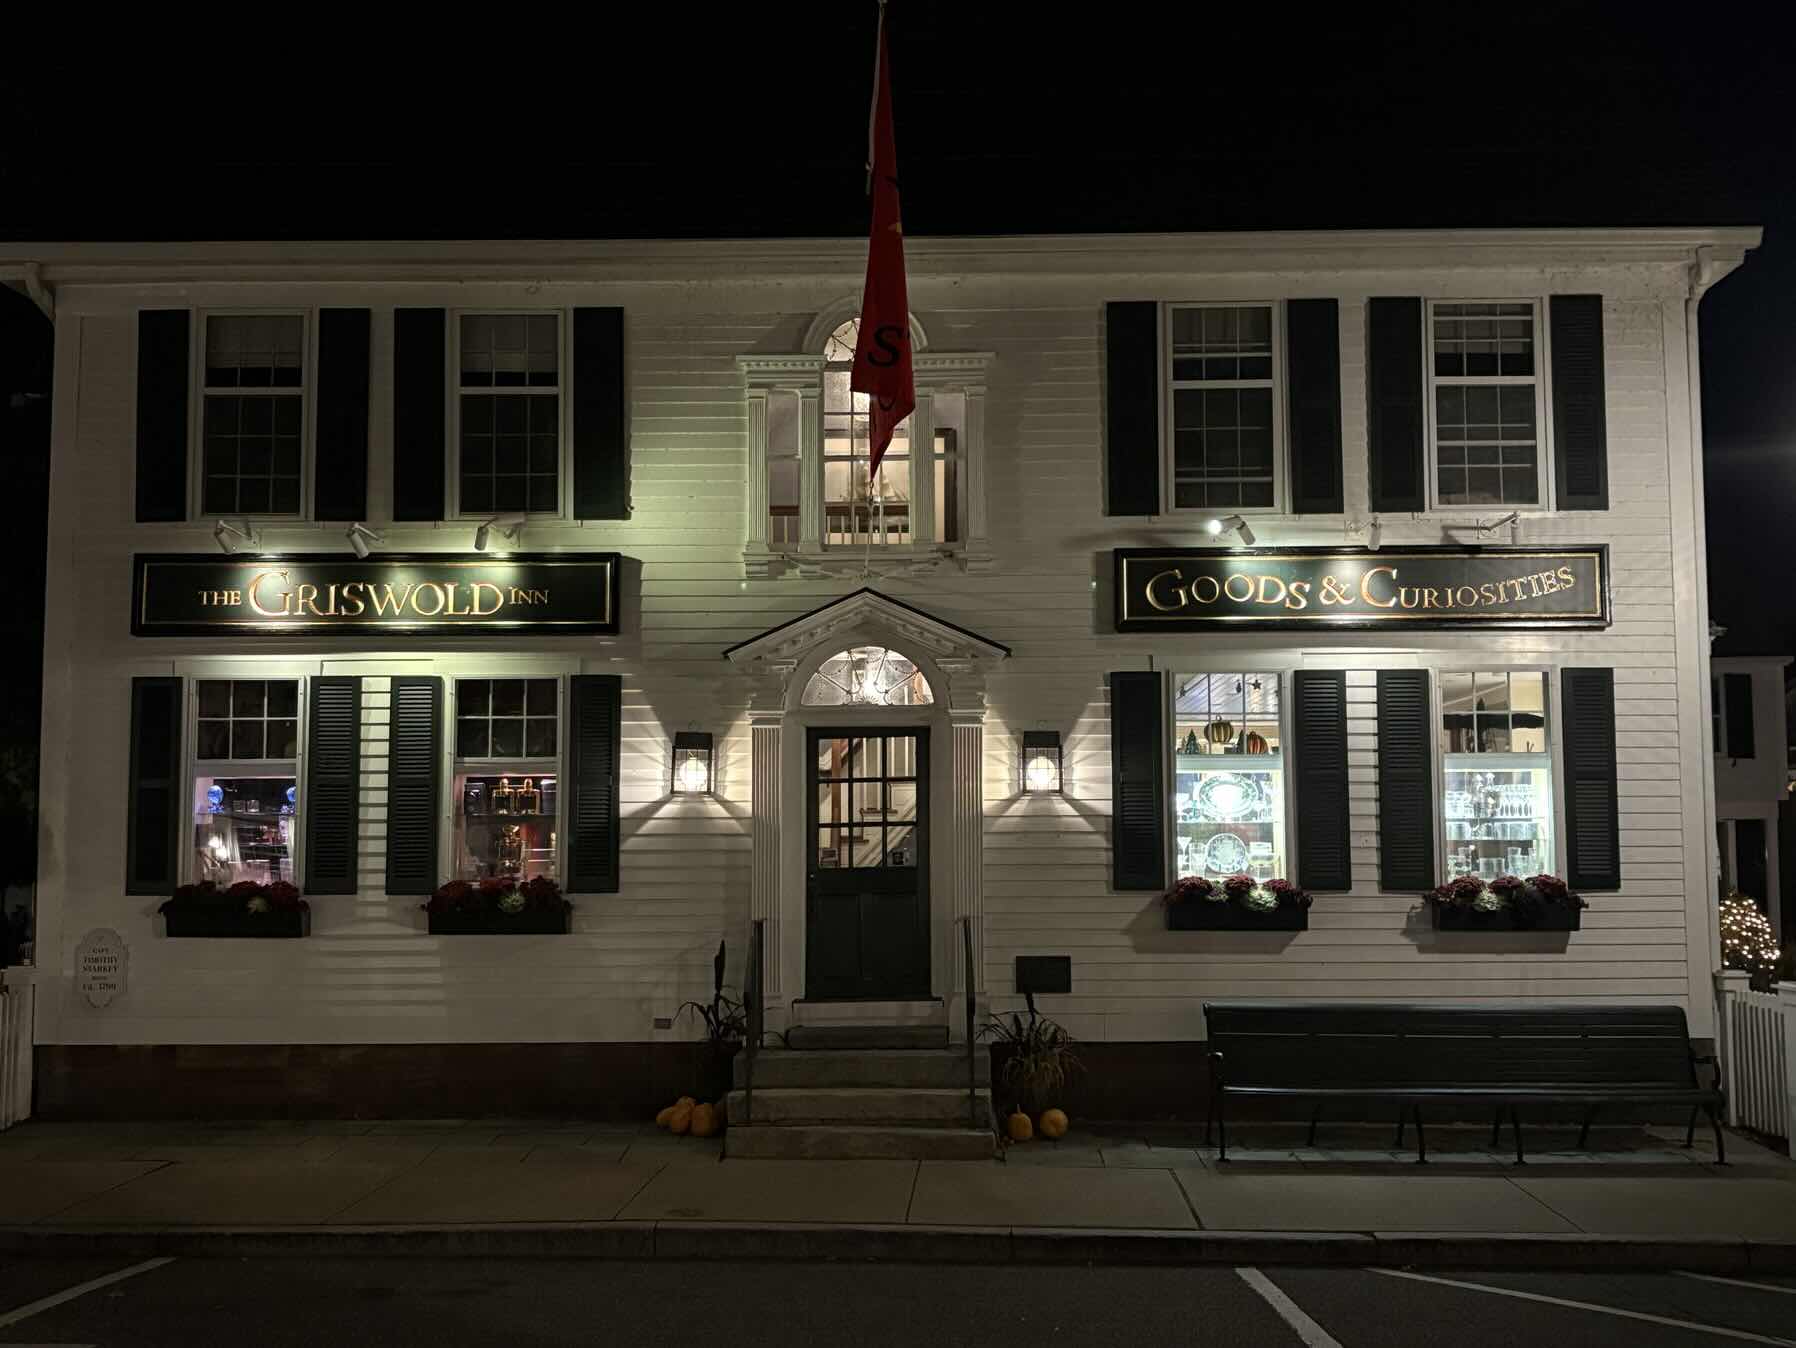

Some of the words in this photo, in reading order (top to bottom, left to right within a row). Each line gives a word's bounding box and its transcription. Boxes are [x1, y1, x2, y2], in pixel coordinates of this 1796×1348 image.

[198, 590, 242, 606] THE
[248, 569, 505, 617] GRISWOLD
[508, 586, 550, 605] INN
[1145, 568, 1311, 612] GOODS
[1318, 575, 1356, 605] &
[1360, 564, 1577, 609] CURIOSITIES
